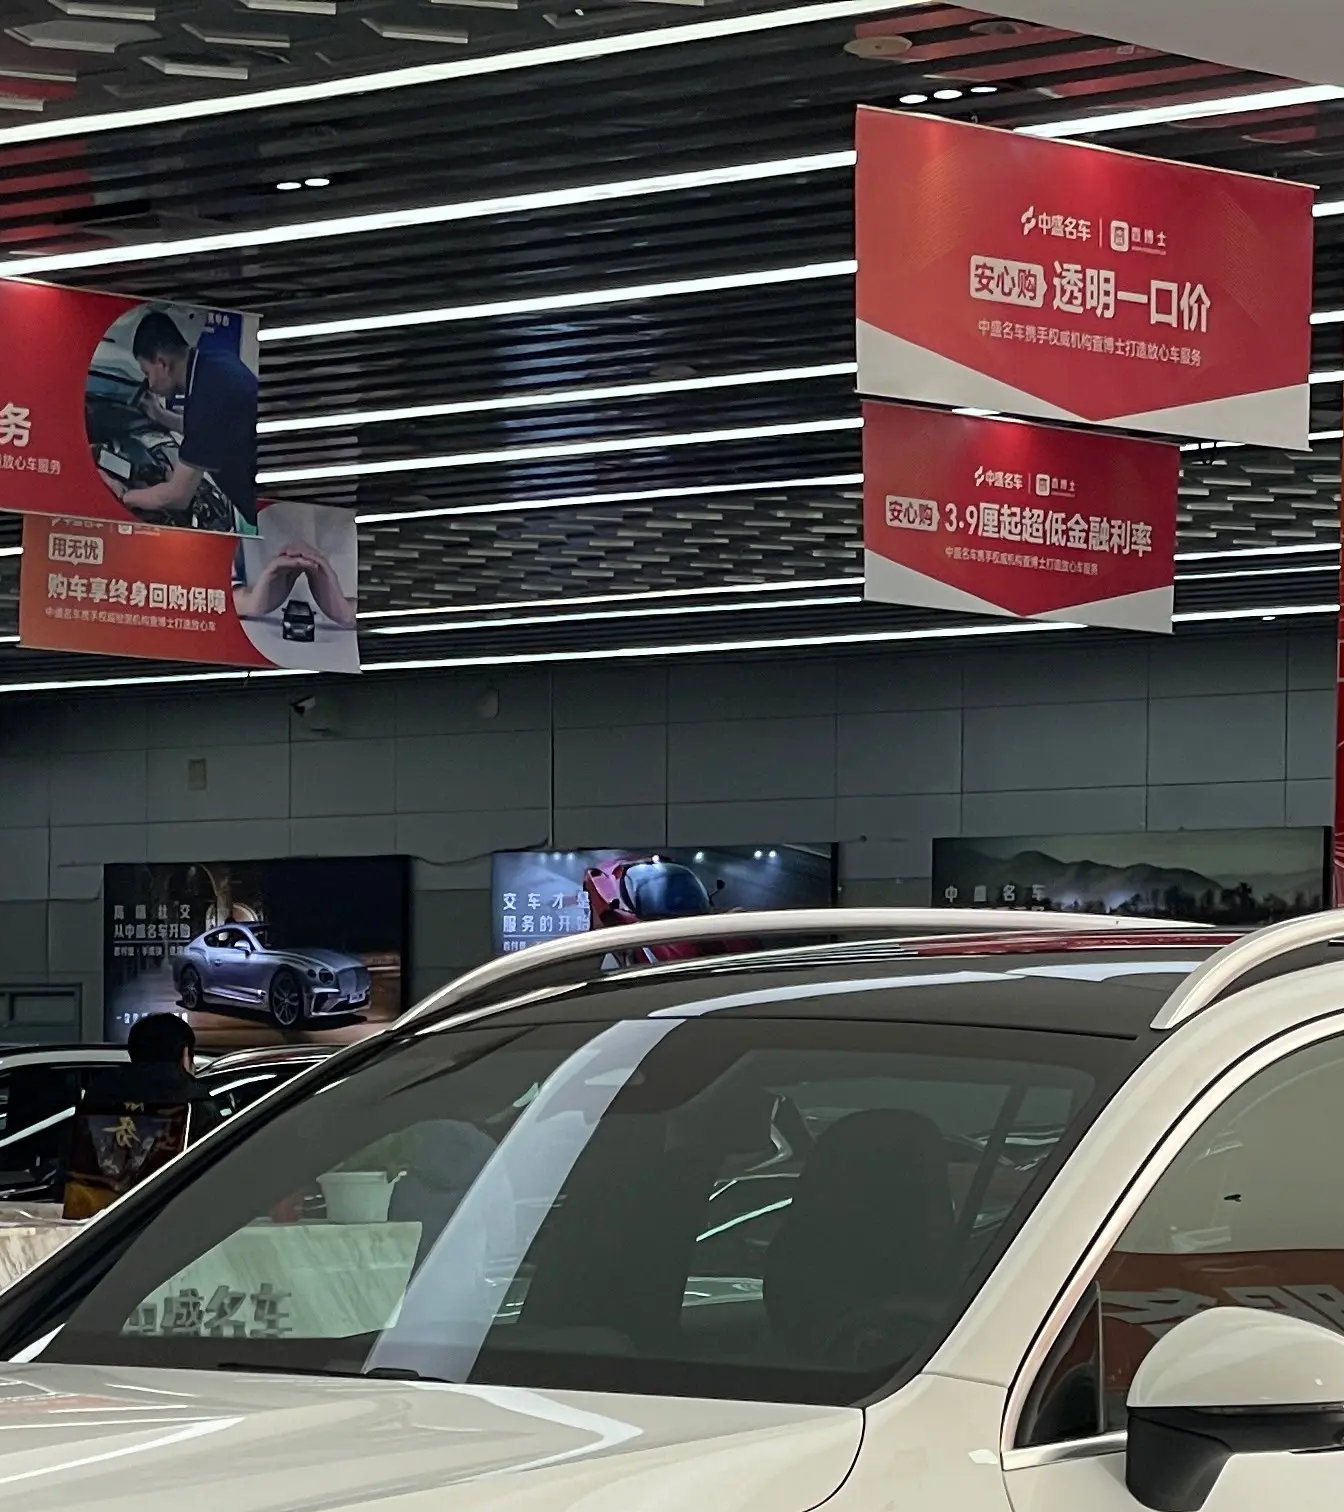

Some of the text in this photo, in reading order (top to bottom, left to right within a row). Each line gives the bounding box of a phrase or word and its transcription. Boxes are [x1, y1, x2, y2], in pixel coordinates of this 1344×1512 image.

[1038, 212, 1091, 242] 中盛名车
[975, 260, 1211, 333] 安心购 透明一口价
[985, 469, 1023, 489] 中盛名车
[889, 501, 1152, 557] 安心购 3.9厘起超低金融利率
[52, 537, 99, 561] 用无忧
[47, 574, 226, 614] 购车享终身回购保障
[503, 892, 590, 910] 交车才是
[503, 915, 590, 932] 服务的开始
